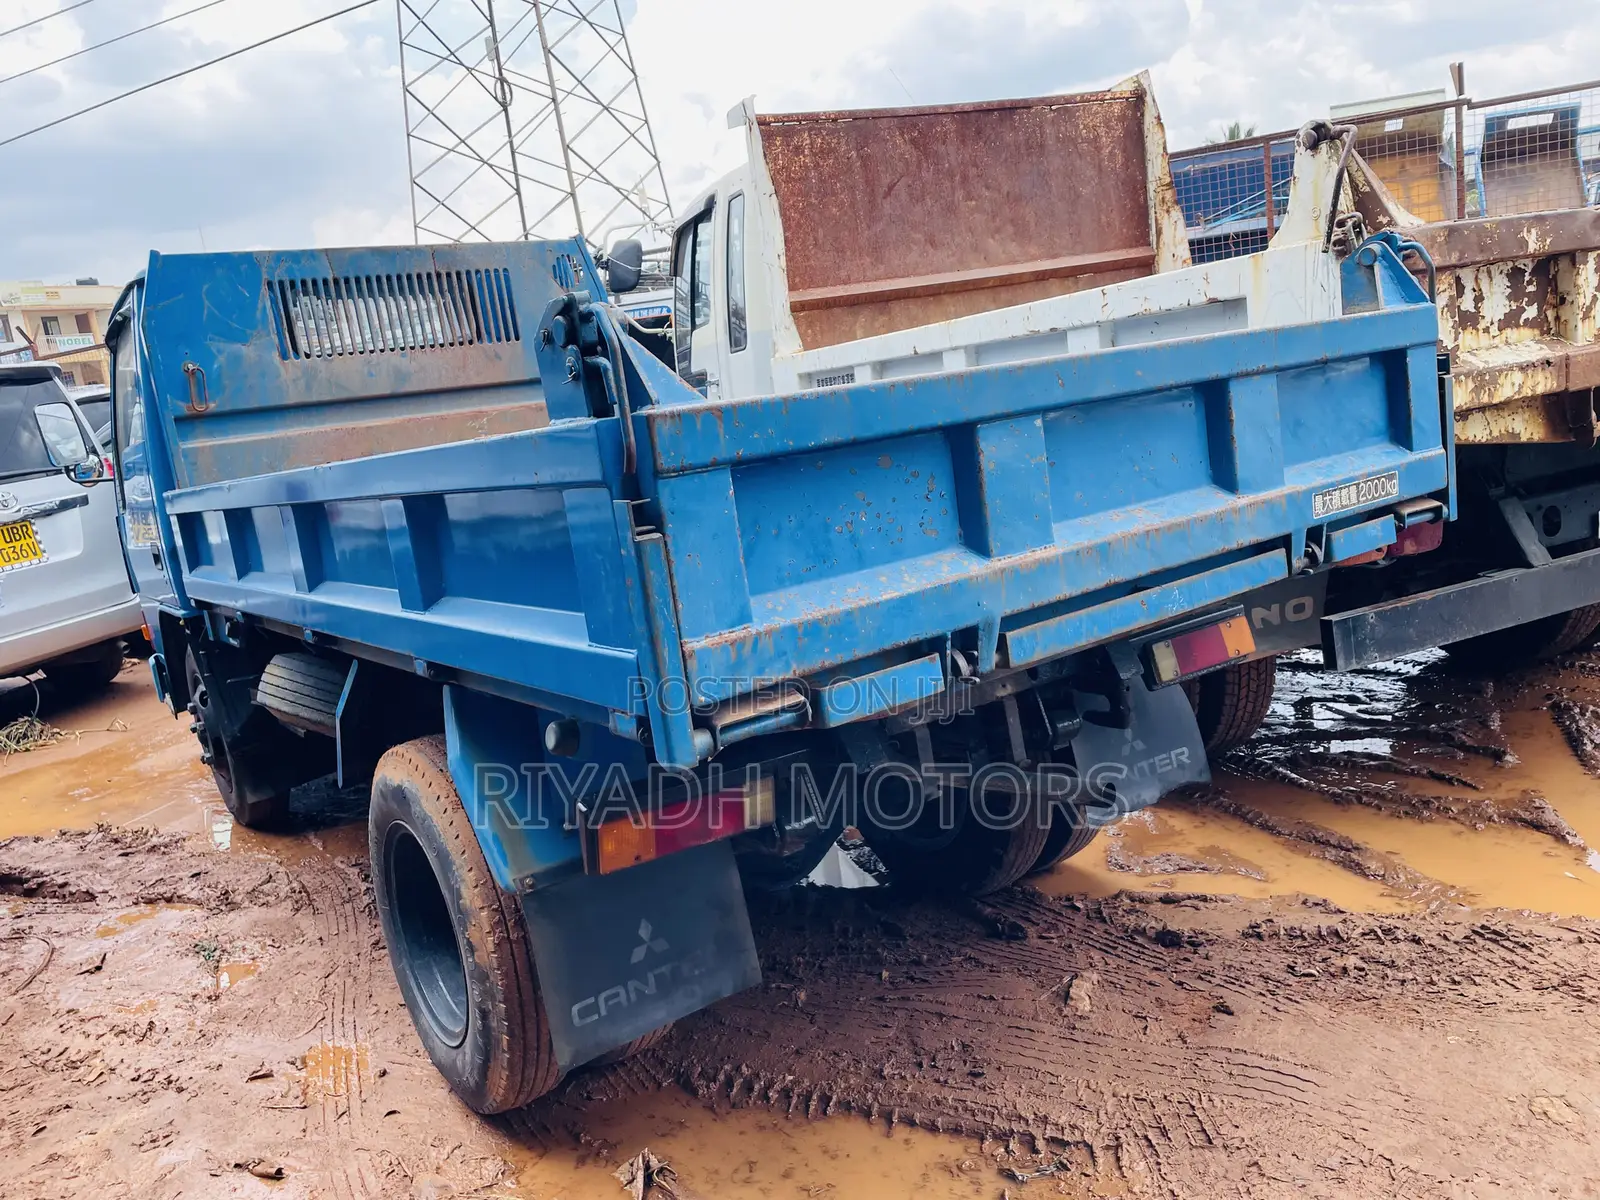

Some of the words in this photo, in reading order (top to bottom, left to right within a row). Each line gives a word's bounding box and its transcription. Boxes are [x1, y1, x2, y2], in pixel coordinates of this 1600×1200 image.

[58, 337, 93, 346] NOBEL
[1315, 484, 1358, 514] 最大積載量
[1359, 477, 1397, 501] 2000kg
[0, 523, 32, 544] UBR
[1251, 596, 1313, 629] NO
[1126, 746, 1191, 780] NTER
[571, 961, 684, 1027] CANT
